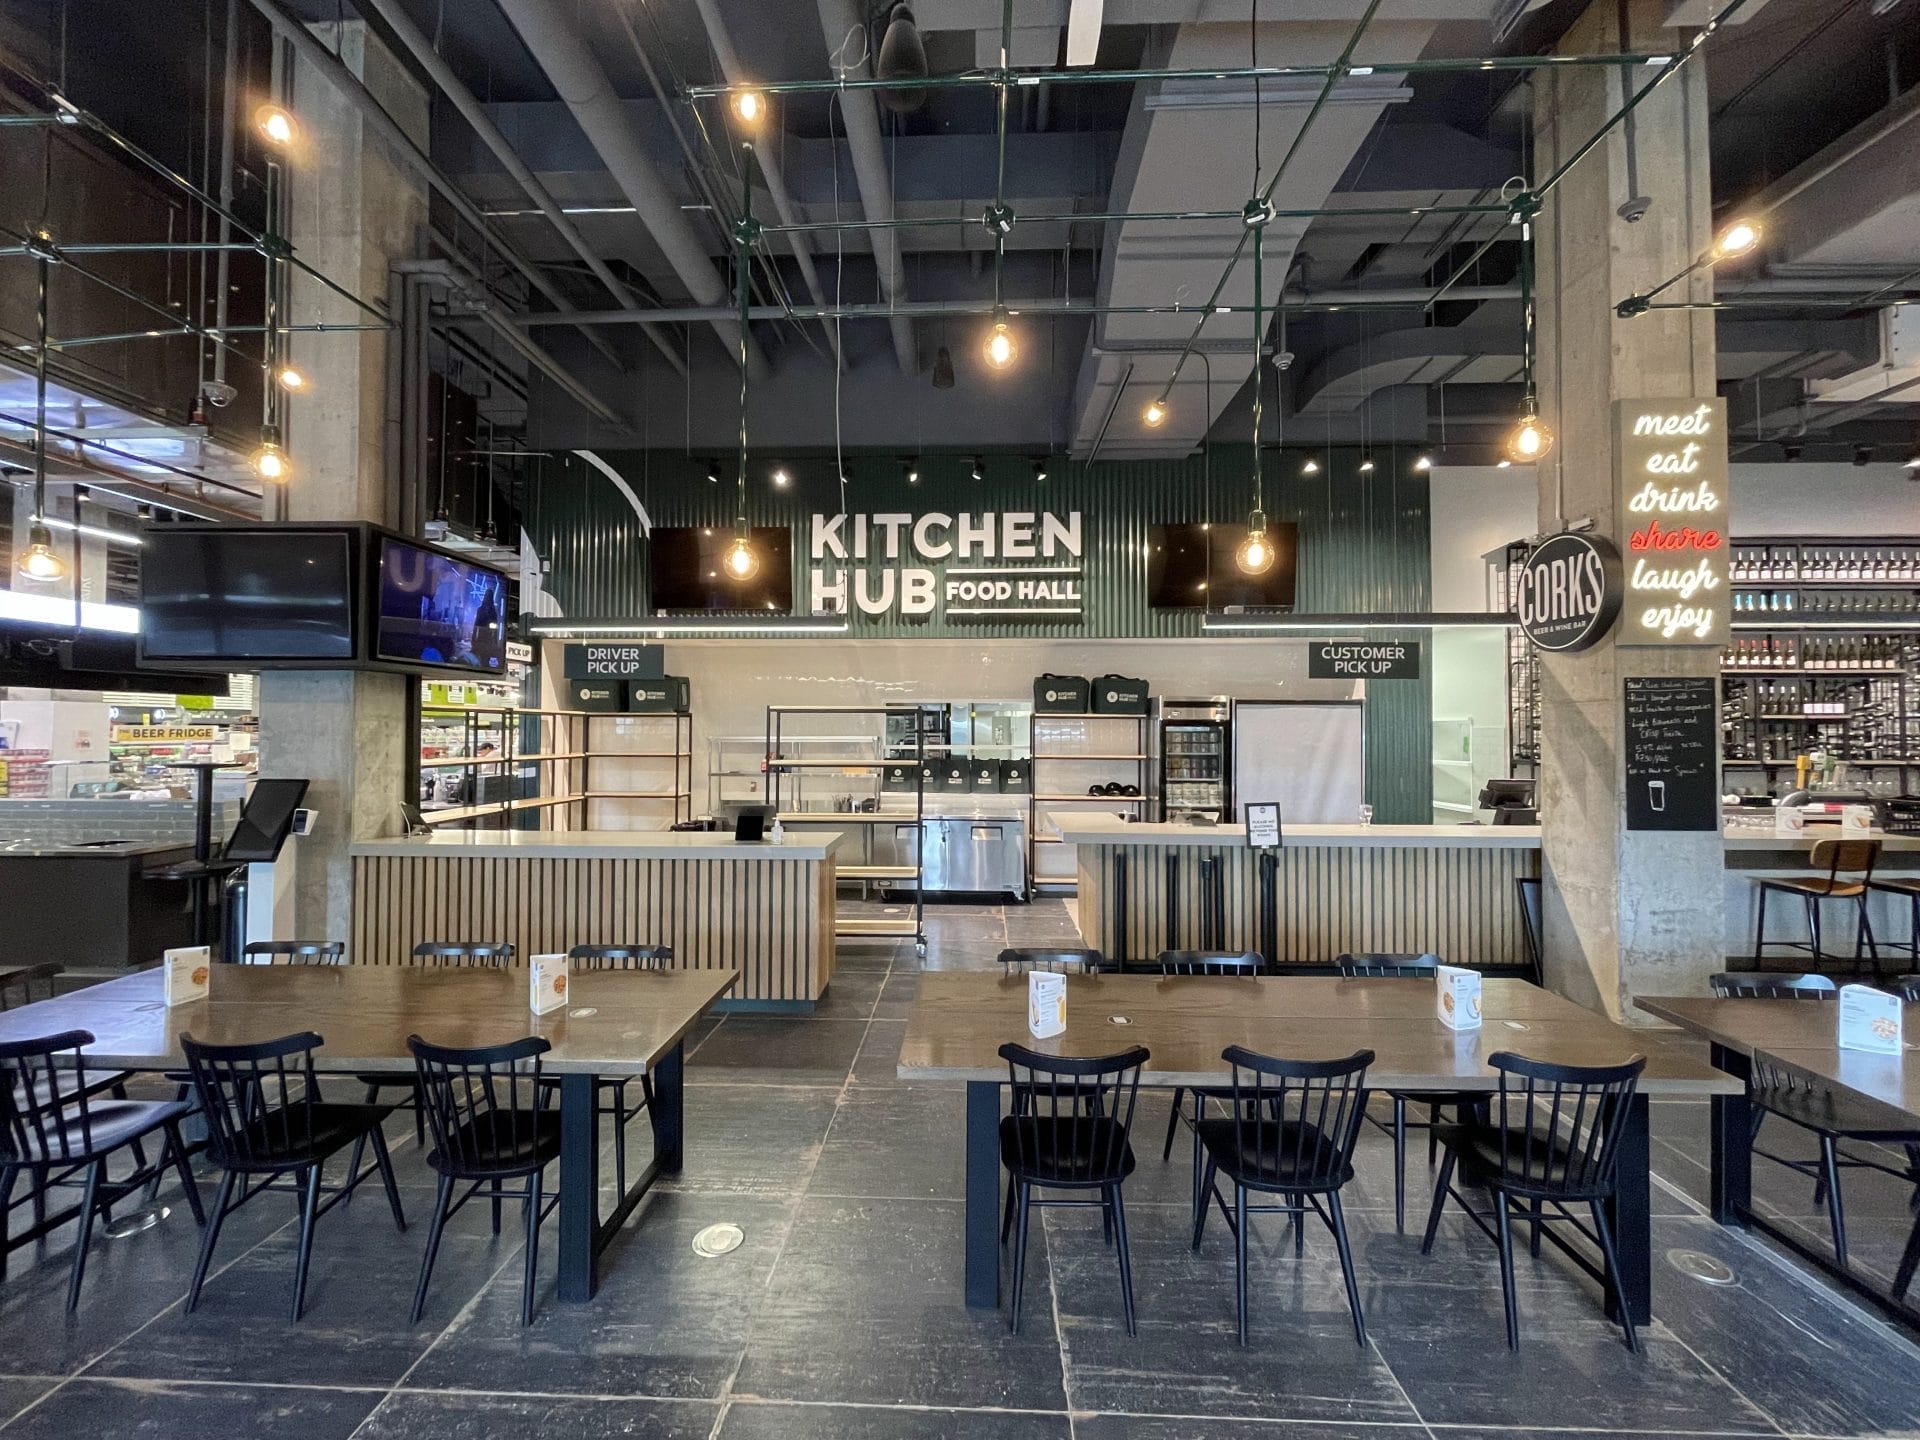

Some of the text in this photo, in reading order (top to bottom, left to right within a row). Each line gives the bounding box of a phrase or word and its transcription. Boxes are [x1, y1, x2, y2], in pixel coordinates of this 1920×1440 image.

[1633, 403, 1712, 435] meet
[1647, 442, 1701, 473] eat
[1629, 480, 1720, 512] drink
[811, 511, 1082, 559] KITCHEN
[1630, 520, 1723, 551] share
[811, 568, 1082, 614] HUB FOOD HALL
[1517, 549, 1602, 626] CORKS
[1631, 557, 1720, 599] laugh
[1533, 626, 1549, 635] BEER
[1555, 622, 1571, 632] WINE
[1573, 620, 1586, 628] BAR
[1641, 603, 1714, 639] enjoy
[508, 646, 530, 657] PICK UP
[587, 648, 640, 660] DRIVER
[1321, 646, 1405, 659] CUSTOMER
[587, 661, 640, 674] PICK UP
[1334, 661, 1392, 674] PICK UP
[132, 728, 165, 738] BEER
[168, 728, 213, 738] FRIDGE
